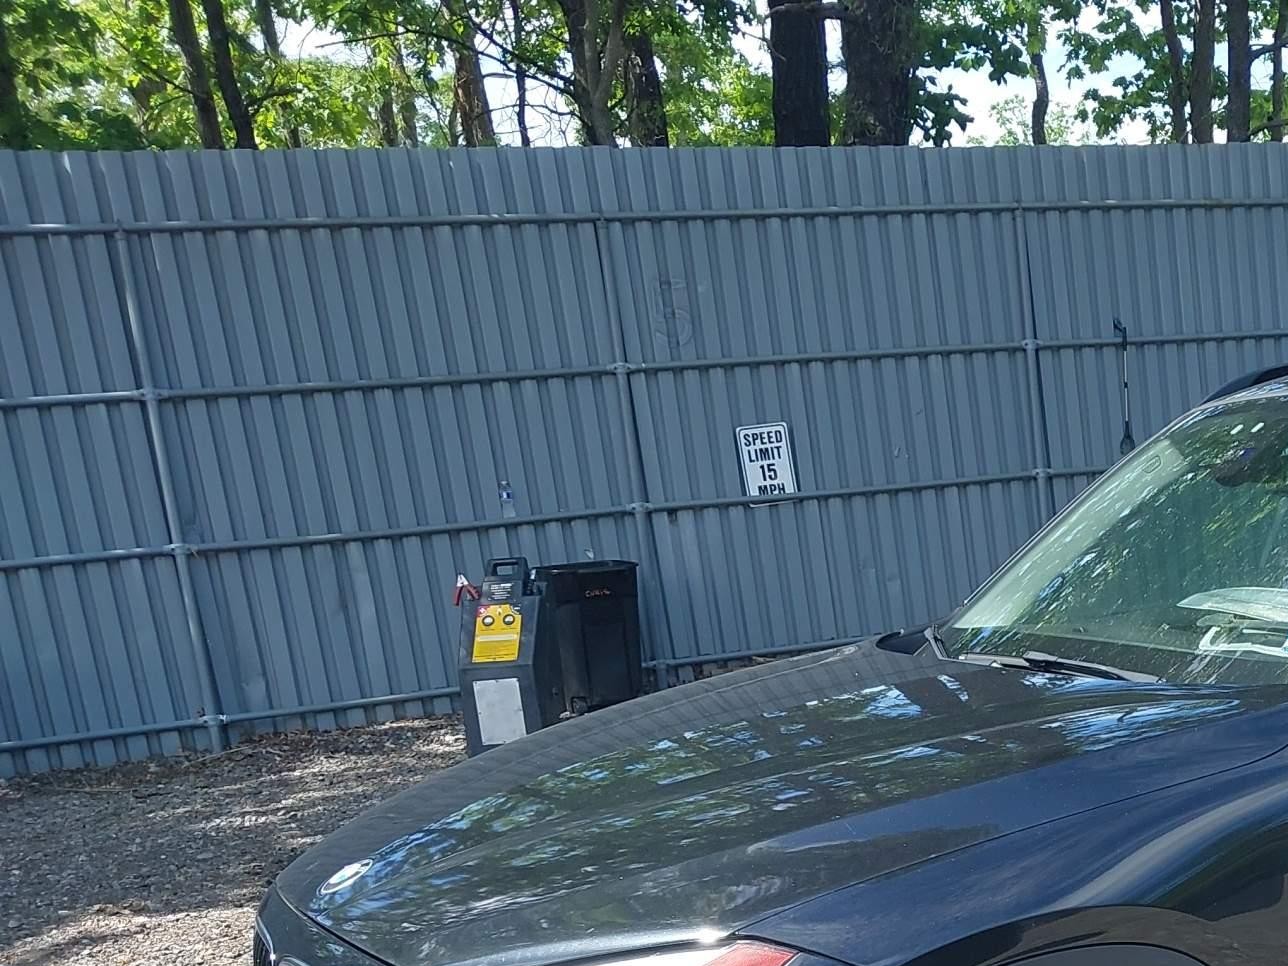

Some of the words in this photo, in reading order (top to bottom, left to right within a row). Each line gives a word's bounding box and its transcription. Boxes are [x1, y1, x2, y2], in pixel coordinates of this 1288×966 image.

[743, 430, 783, 447] SPEED
[747, 446, 782, 463] LIMIT
[759, 463, 778, 481] 15
[757, 482, 786, 496] MPH
